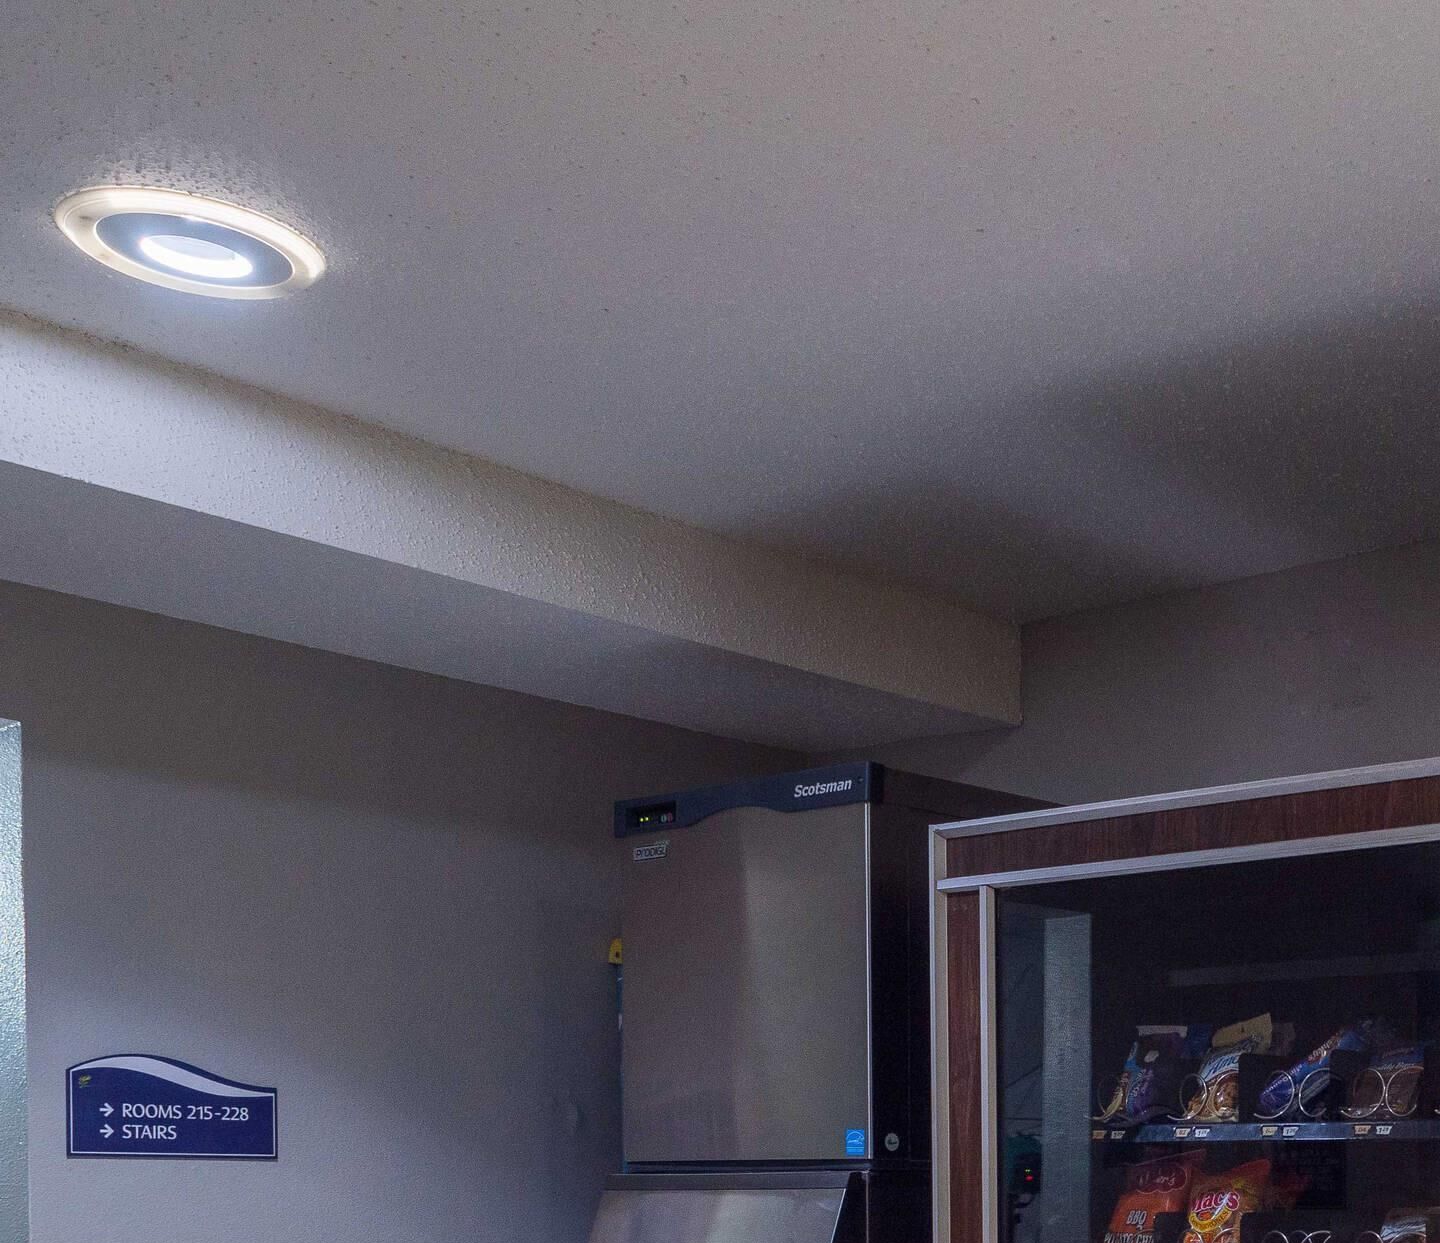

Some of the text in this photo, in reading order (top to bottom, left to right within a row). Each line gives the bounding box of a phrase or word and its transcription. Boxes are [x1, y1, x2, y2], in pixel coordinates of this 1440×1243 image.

[794, 779, 852, 798] Scotsman
[122, 1103, 249, 1121] ROOMS 215-228
[122, 1124, 177, 1140] STAIRS
[1126, 1210, 1147, 1225] BBQ
